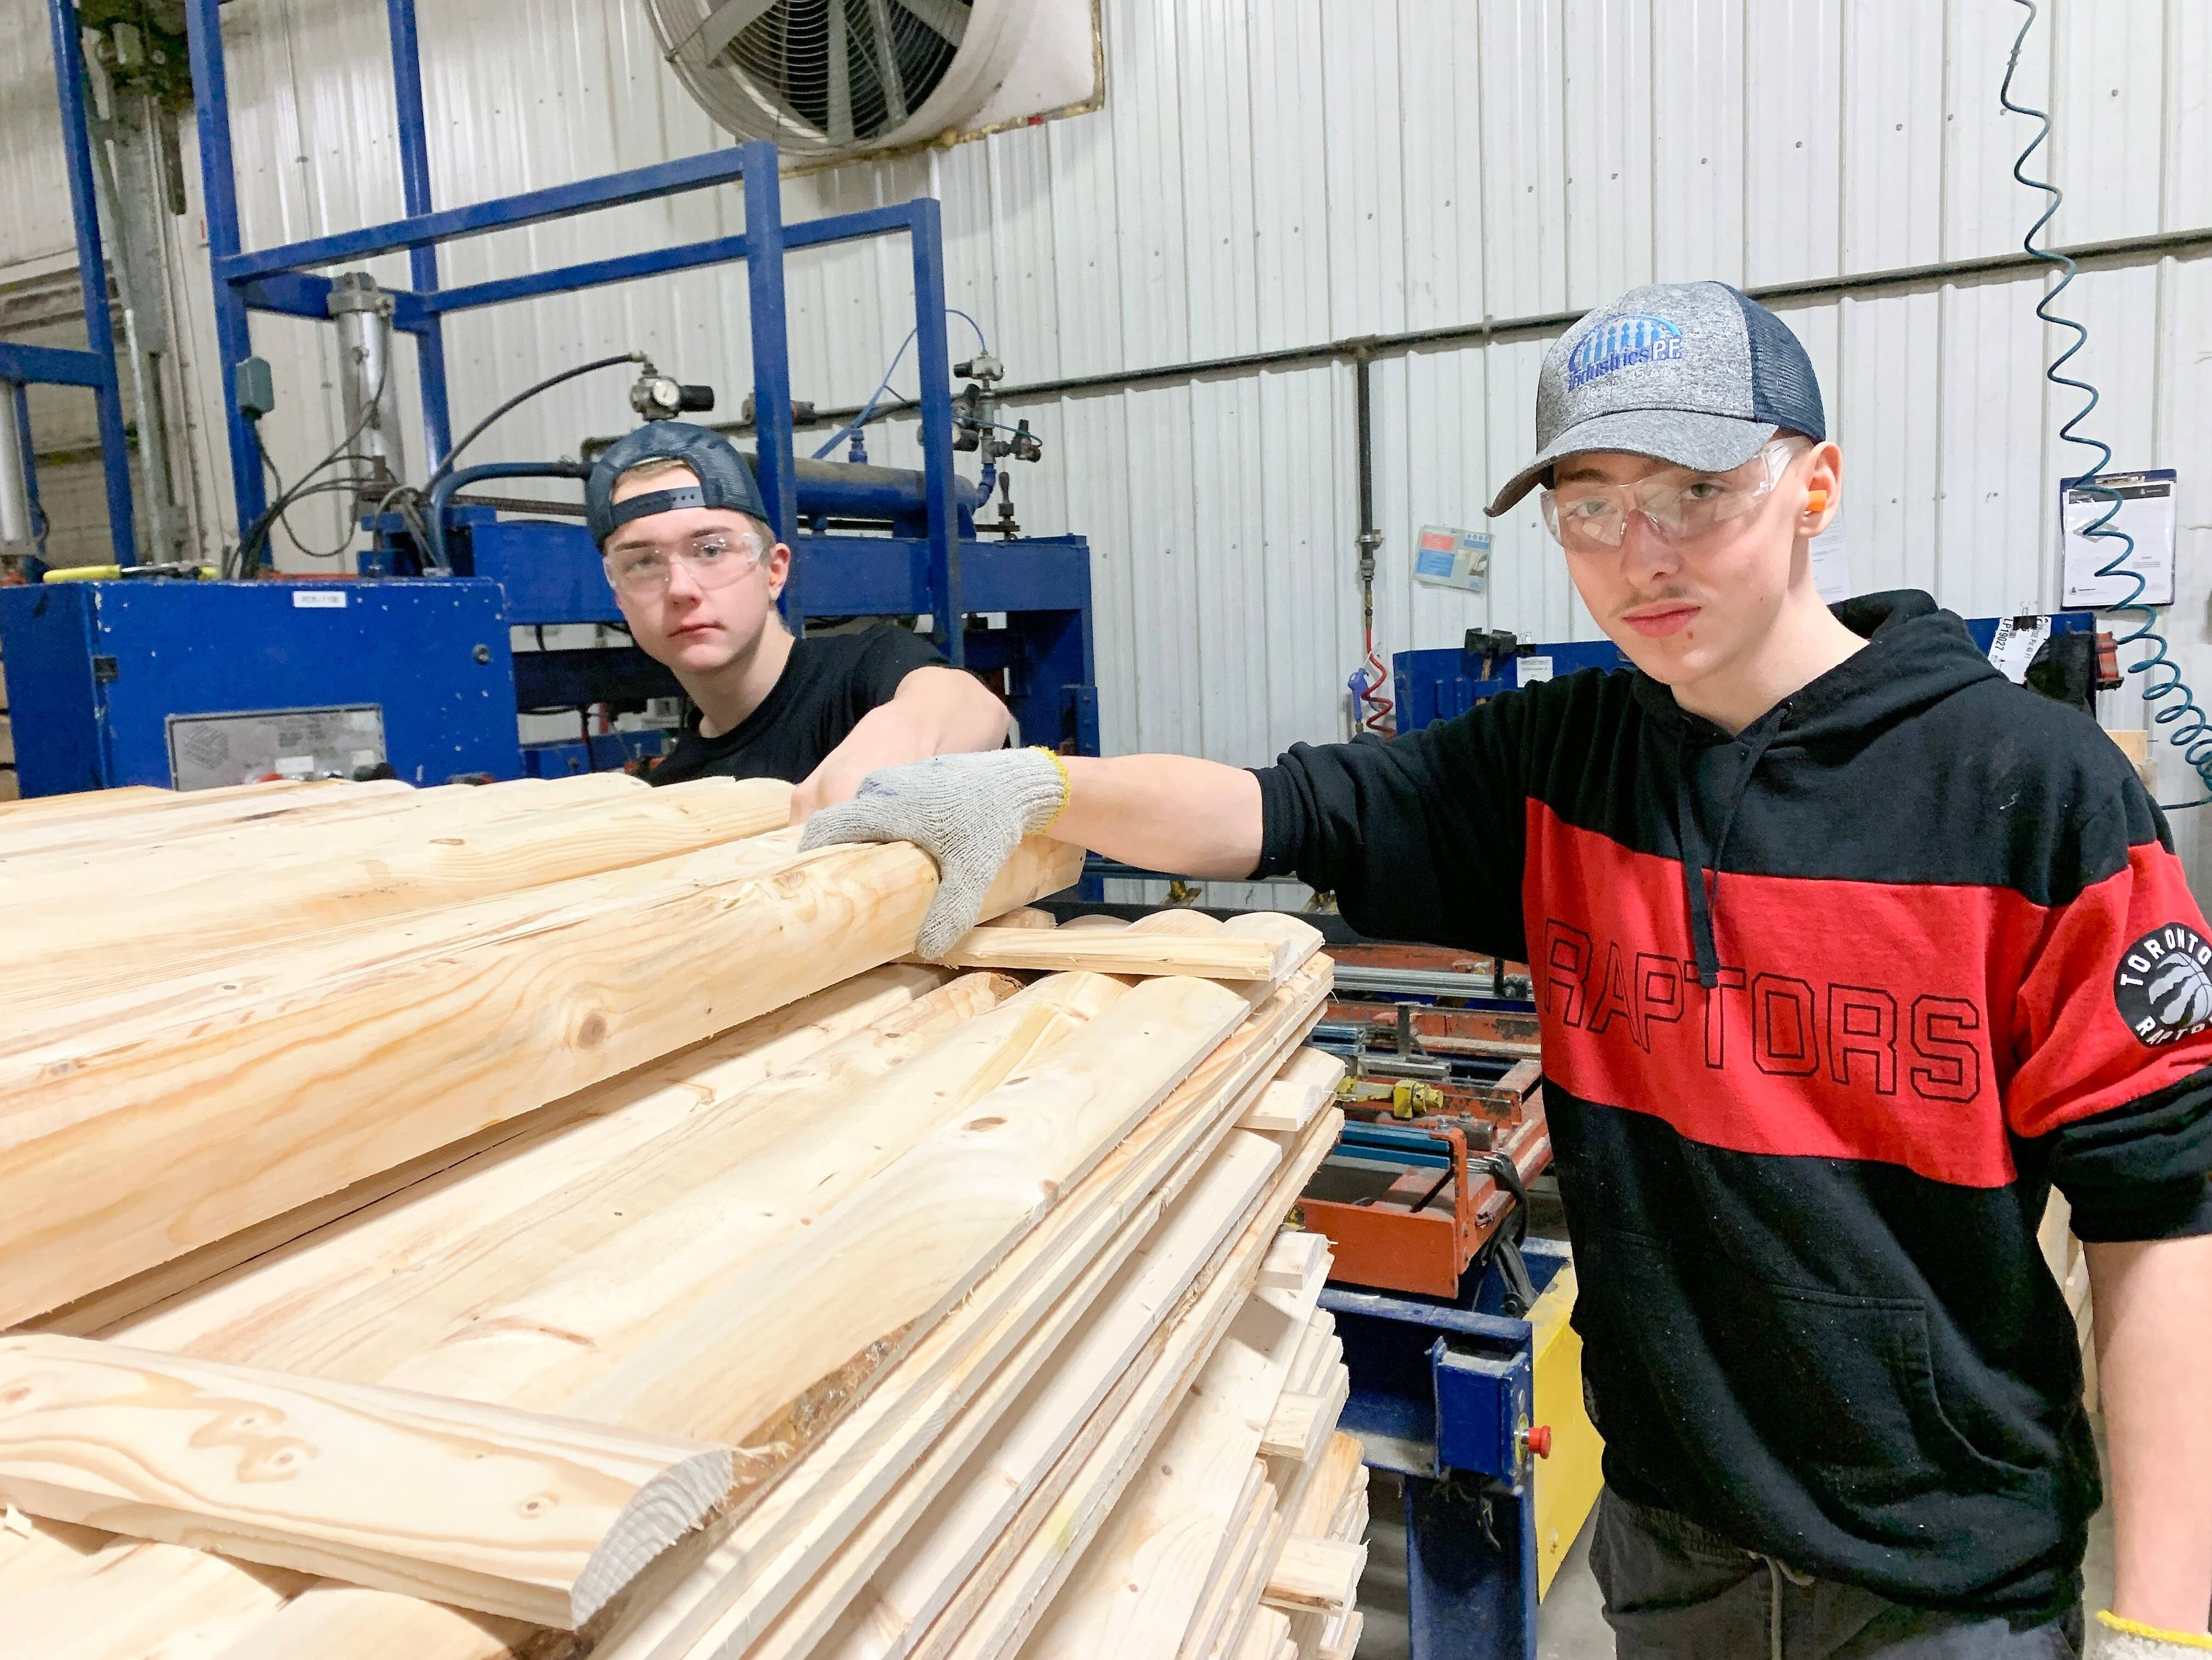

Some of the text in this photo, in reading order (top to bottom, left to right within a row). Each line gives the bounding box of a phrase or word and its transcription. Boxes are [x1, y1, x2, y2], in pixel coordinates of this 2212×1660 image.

[1995, 618, 2013, 651] LP19027
[2120, 928, 2212, 986] TORONTO
[1544, 918, 1980, 1103] RAPTORS
[2135, 1015, 2212, 1045] RAPTO
